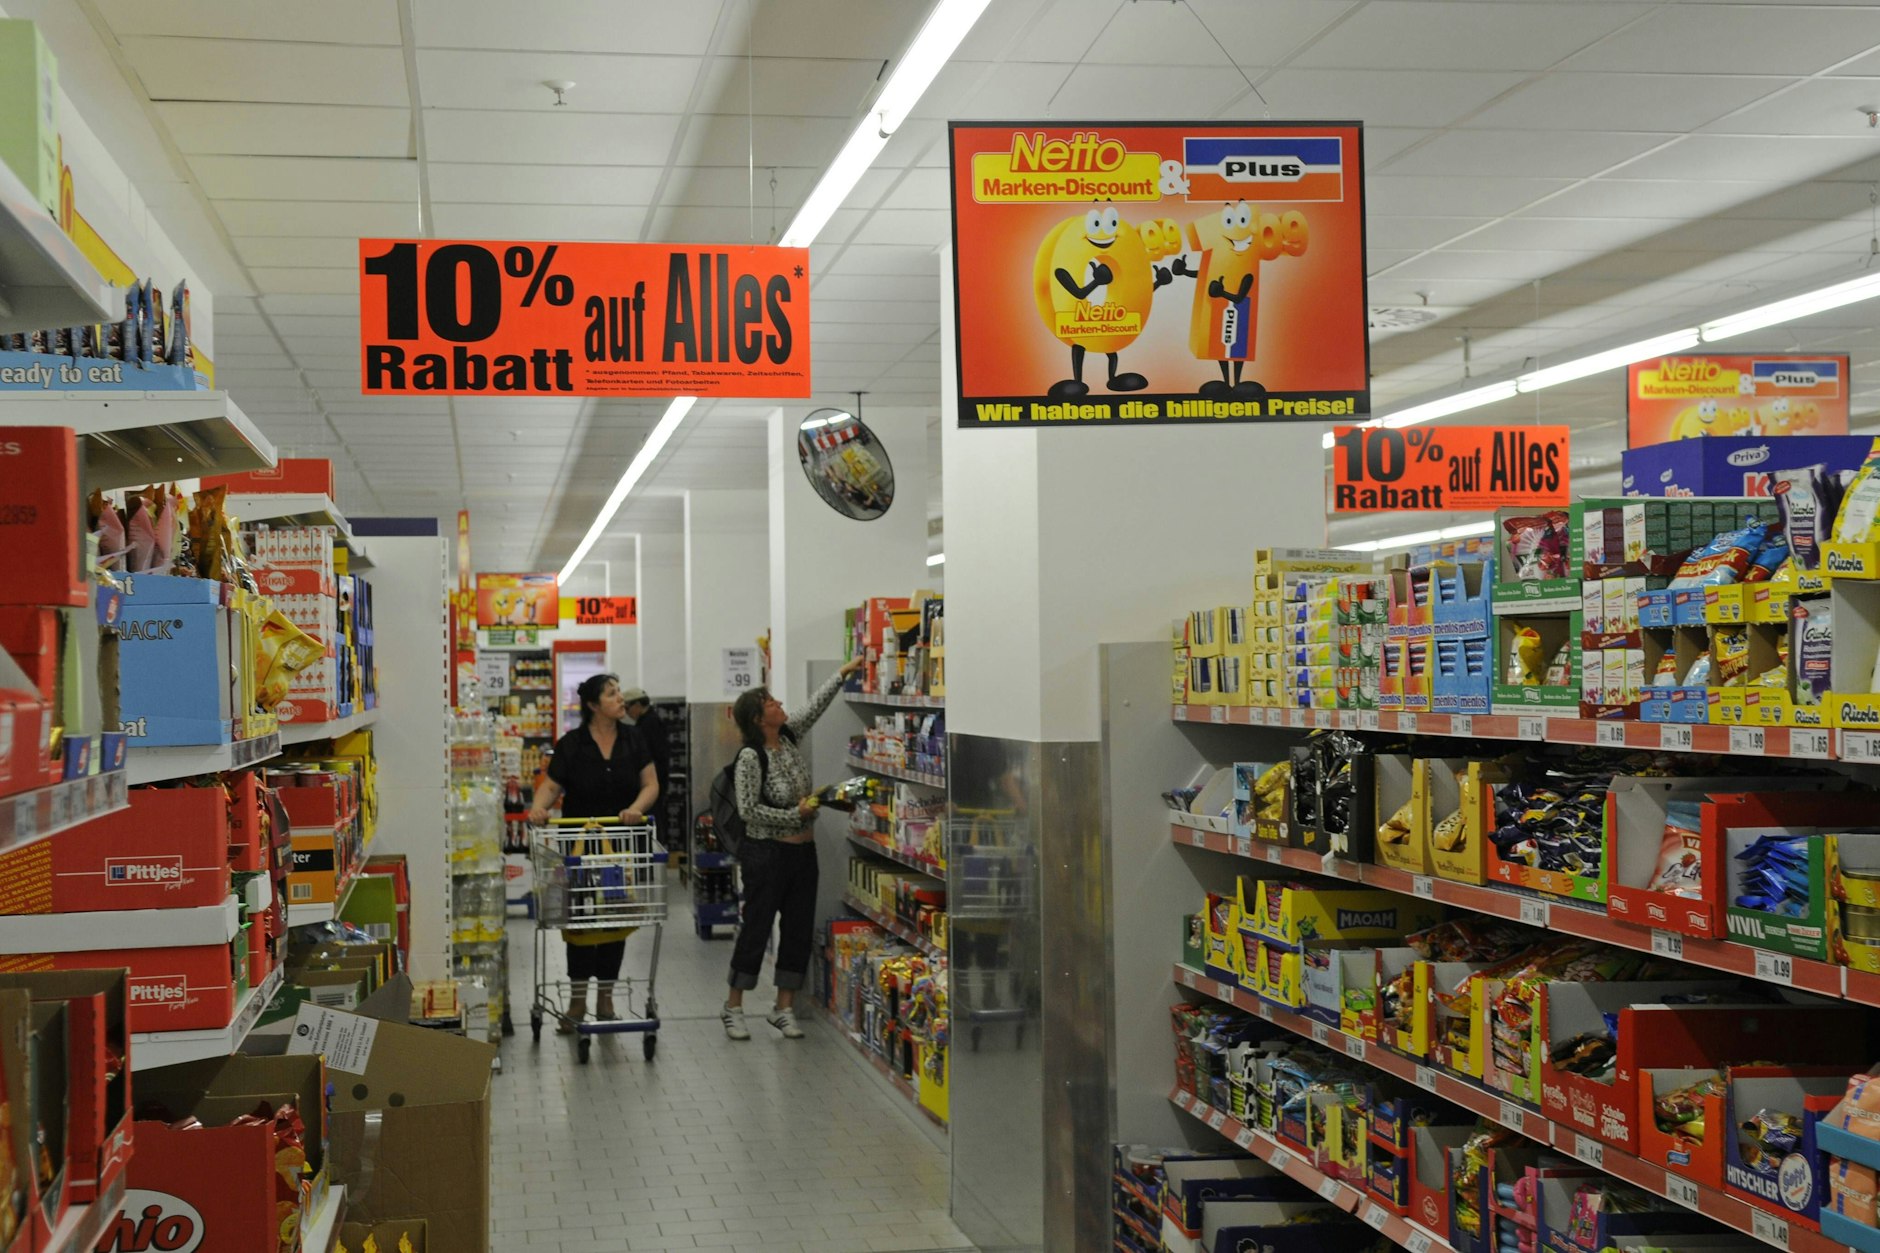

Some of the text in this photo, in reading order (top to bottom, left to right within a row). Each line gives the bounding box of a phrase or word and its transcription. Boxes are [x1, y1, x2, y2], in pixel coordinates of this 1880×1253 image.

[1011, 133, 1125, 172] Netto
[1225, 161, 1301, 178] Plus
[983, 178, 1153, 196] Marken-Discount
[365, 243, 574, 343] 10%
[584, 281, 646, 362] auf
[1075, 302, 1127, 322] Netto
[1060, 323, 1138, 336] Marken-Discount
[1223, 309, 1235, 344] Plus
[0, 364, 123, 390] eady to eat
[366, 345, 574, 391] Rabatt
[1660, 361, 1721, 383] Netto
[1775, 374, 1816, 385] Plus
[1643, 384, 1736, 396] Marken-Discount
[977, 397, 1355, 421] Wir haben die billigen Preise!
[1336, 428, 1444, 484] 10%
[1449, 450, 1481, 492] auf
[1733, 449, 1762, 464] Priva
[1336, 484, 1443, 510] Rabatt
[1828, 551, 1864, 572] Ricola
[260, 576, 296, 587] MIKADO
[1799, 576, 1823, 589] Ricola
[577, 597, 614, 616] 10%
[577, 615, 613, 624] Rabatt
[1434, 621, 1459, 634] mentos
[1459, 620, 1485, 633] mentos
[1409, 623, 1432, 636] mentos
[1380, 694, 1402, 705] mentos
[1405, 694, 1428, 706] mentos
[1433, 694, 1458, 708] mentos
[1460, 694, 1486, 708] mentos
[1795, 709, 1820, 724] Ricola
[1841, 702, 1880, 723] Ricola
[1677, 729, 1691, 745] 1.99
[1748, 732, 1763, 749] 1.99
[1811, 735, 1828, 753] 1.65
[292, 852, 311, 864] ter
[1340, 913, 1395, 927] MAOAM
[1726, 912, 1766, 940] VIVIL
[1774, 959, 1790, 978] 0.99
[1727, 1164, 1779, 1201] HITSCHLER
[1683, 1186, 1697, 1205] 0.79
[106, 1205, 195, 1252] hio
[1772, 1222, 1788, 1243] 1.49
